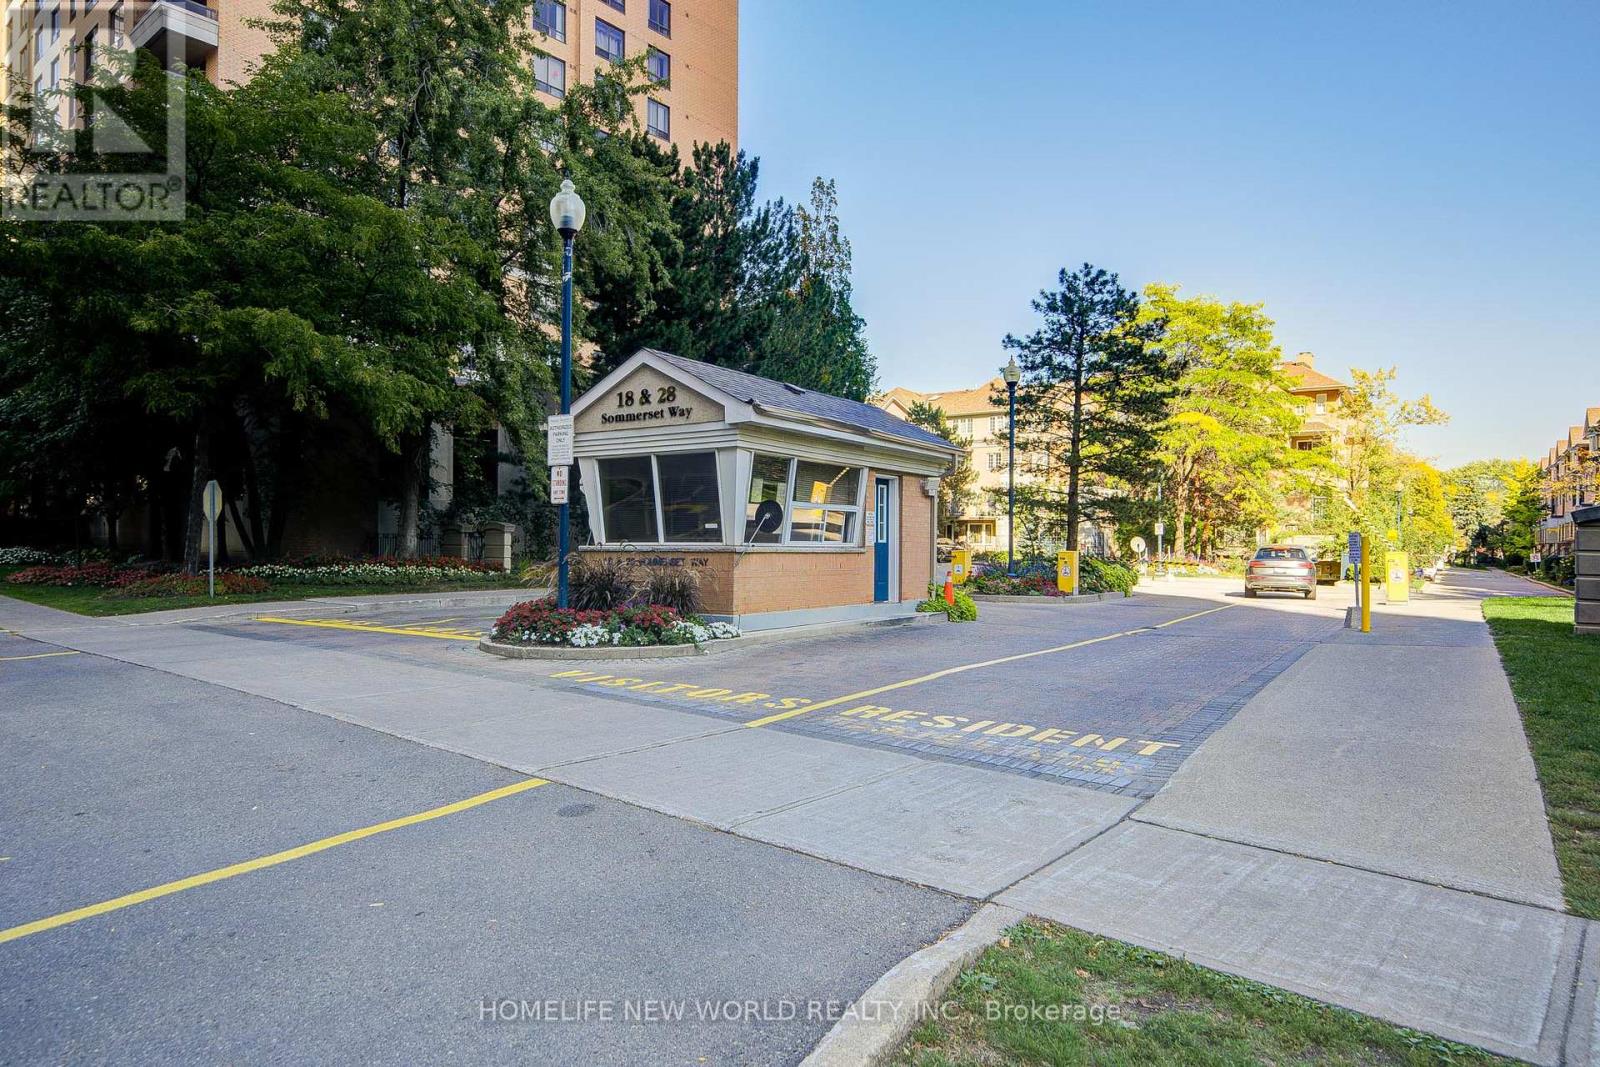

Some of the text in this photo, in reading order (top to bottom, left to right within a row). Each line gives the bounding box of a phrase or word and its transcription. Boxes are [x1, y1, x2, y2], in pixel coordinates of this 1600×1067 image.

[616, 385, 676, 408] 18 & 28
[601, 405, 693, 424] Sommerset Way
[550, 670, 812, 709] VISITORS
[839, 705, 1181, 755] RESIDENT
